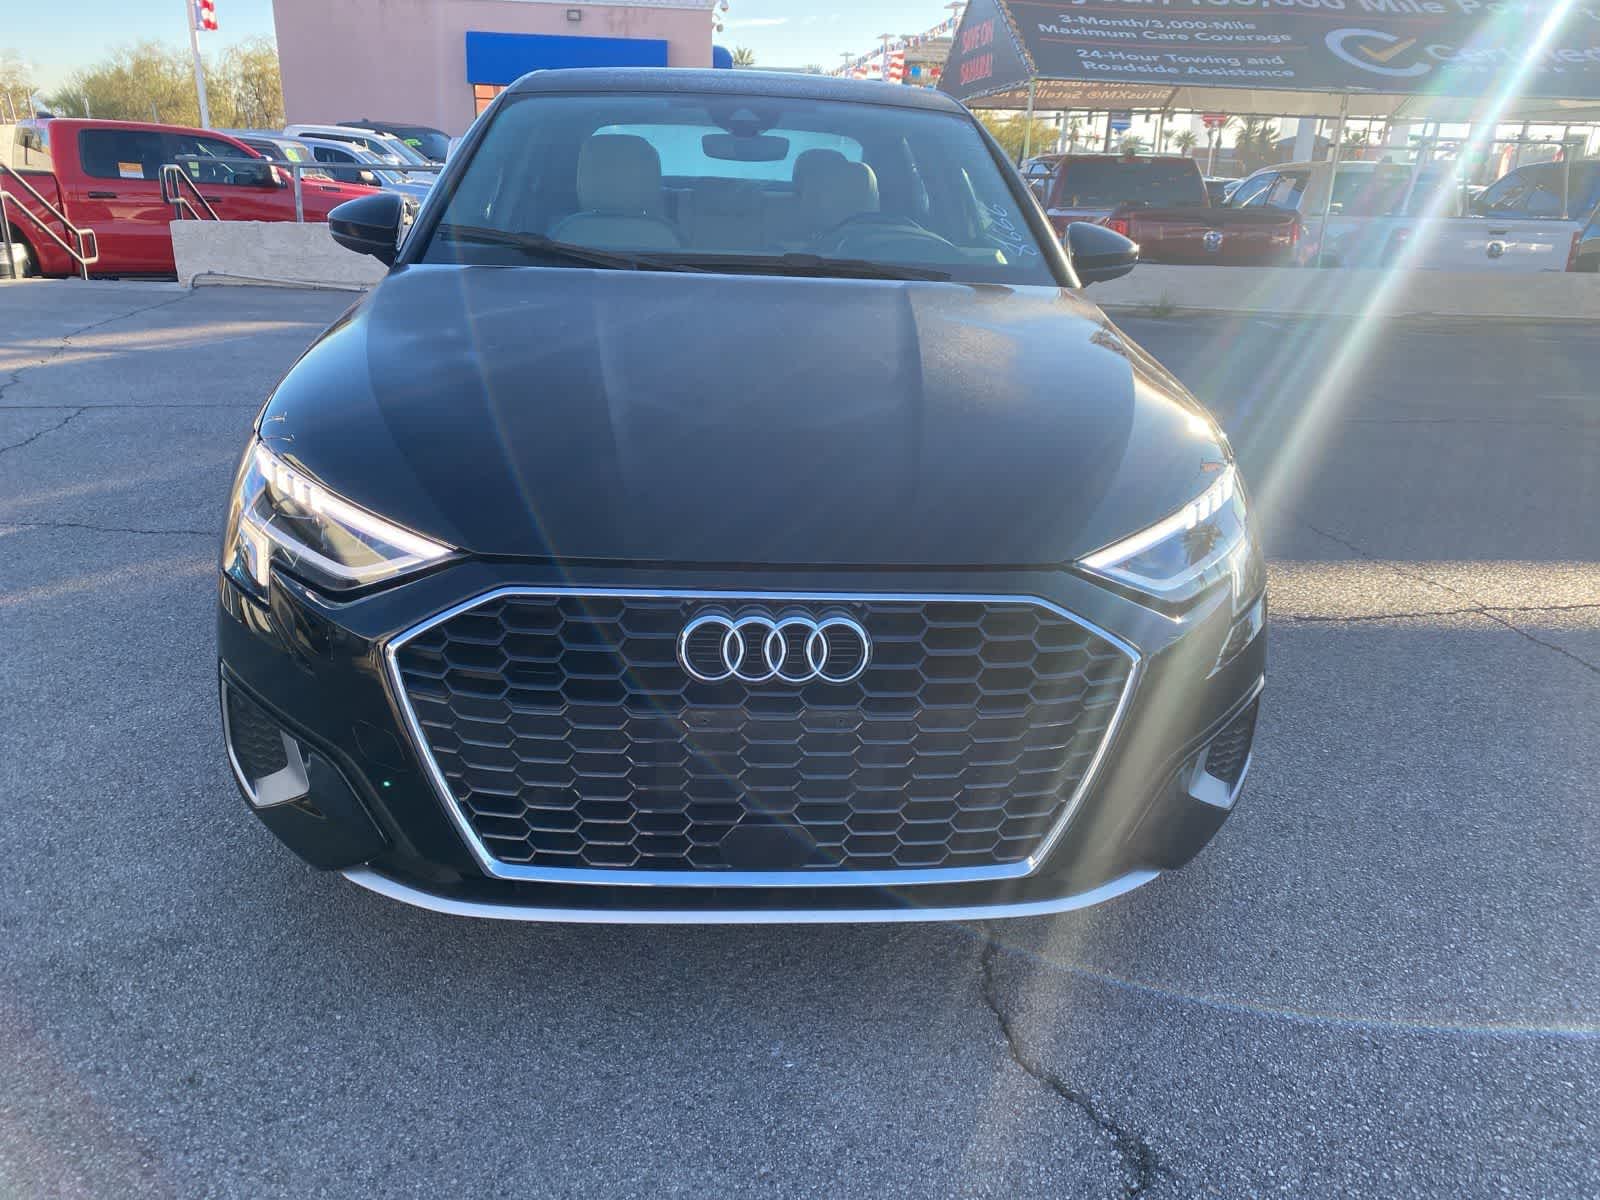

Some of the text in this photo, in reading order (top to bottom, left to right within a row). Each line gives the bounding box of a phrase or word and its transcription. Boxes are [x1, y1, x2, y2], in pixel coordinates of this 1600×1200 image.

[1058, 14, 1257, 31] 3-Month/3,000-Mile
[1038, 23, 1292, 43] Maximum Care Coverage
[1076, 48, 1285, 67] 24-Hour Towing and
[1081, 60, 1295, 78] Roadside Assistance
